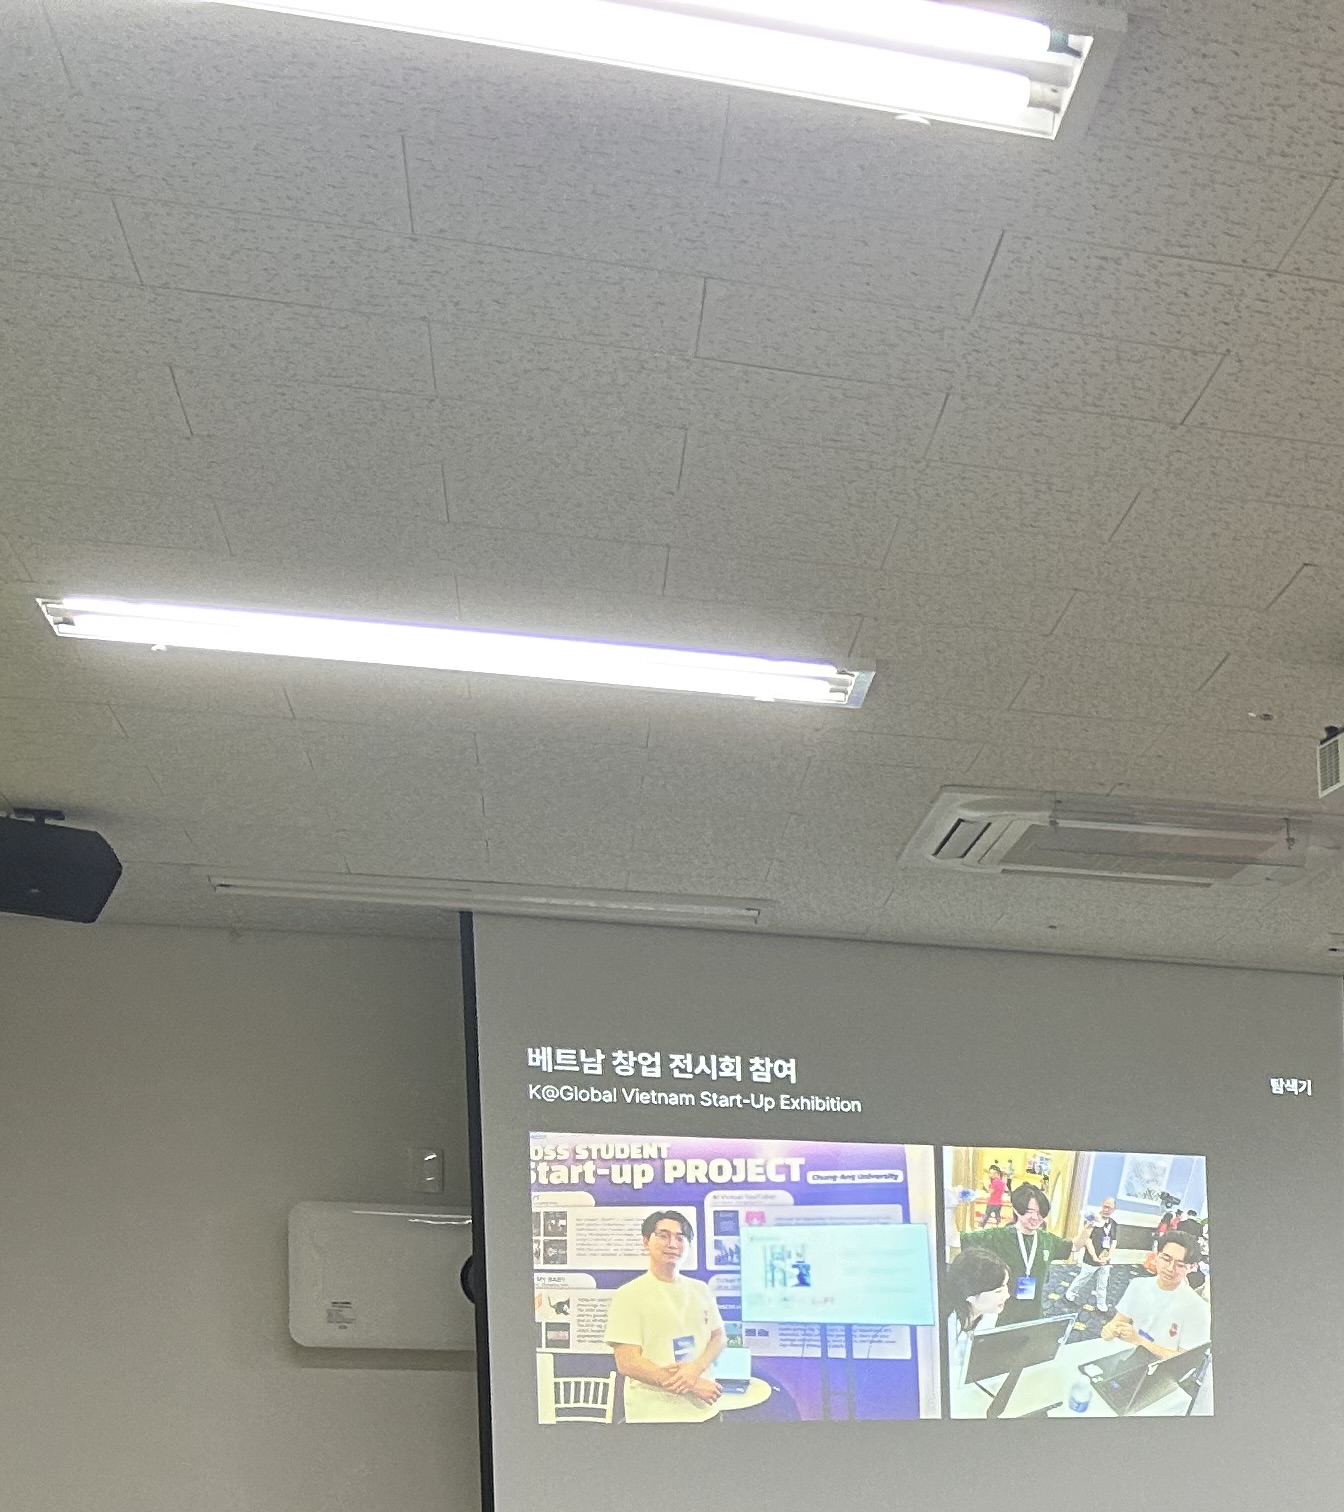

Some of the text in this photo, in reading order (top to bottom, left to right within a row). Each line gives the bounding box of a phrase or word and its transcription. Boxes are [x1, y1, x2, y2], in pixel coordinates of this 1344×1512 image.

[528, 1046, 797, 1084] 베트남 창업 전시회 참여
[529, 1084, 862, 1113] K@Global Vietnam Start-Up Exhibition
[1270, 1077, 1312, 1096] 탐색기
[575, 1143, 669, 1160] STUDENT
[665, 1157, 805, 1184] PROJECT
